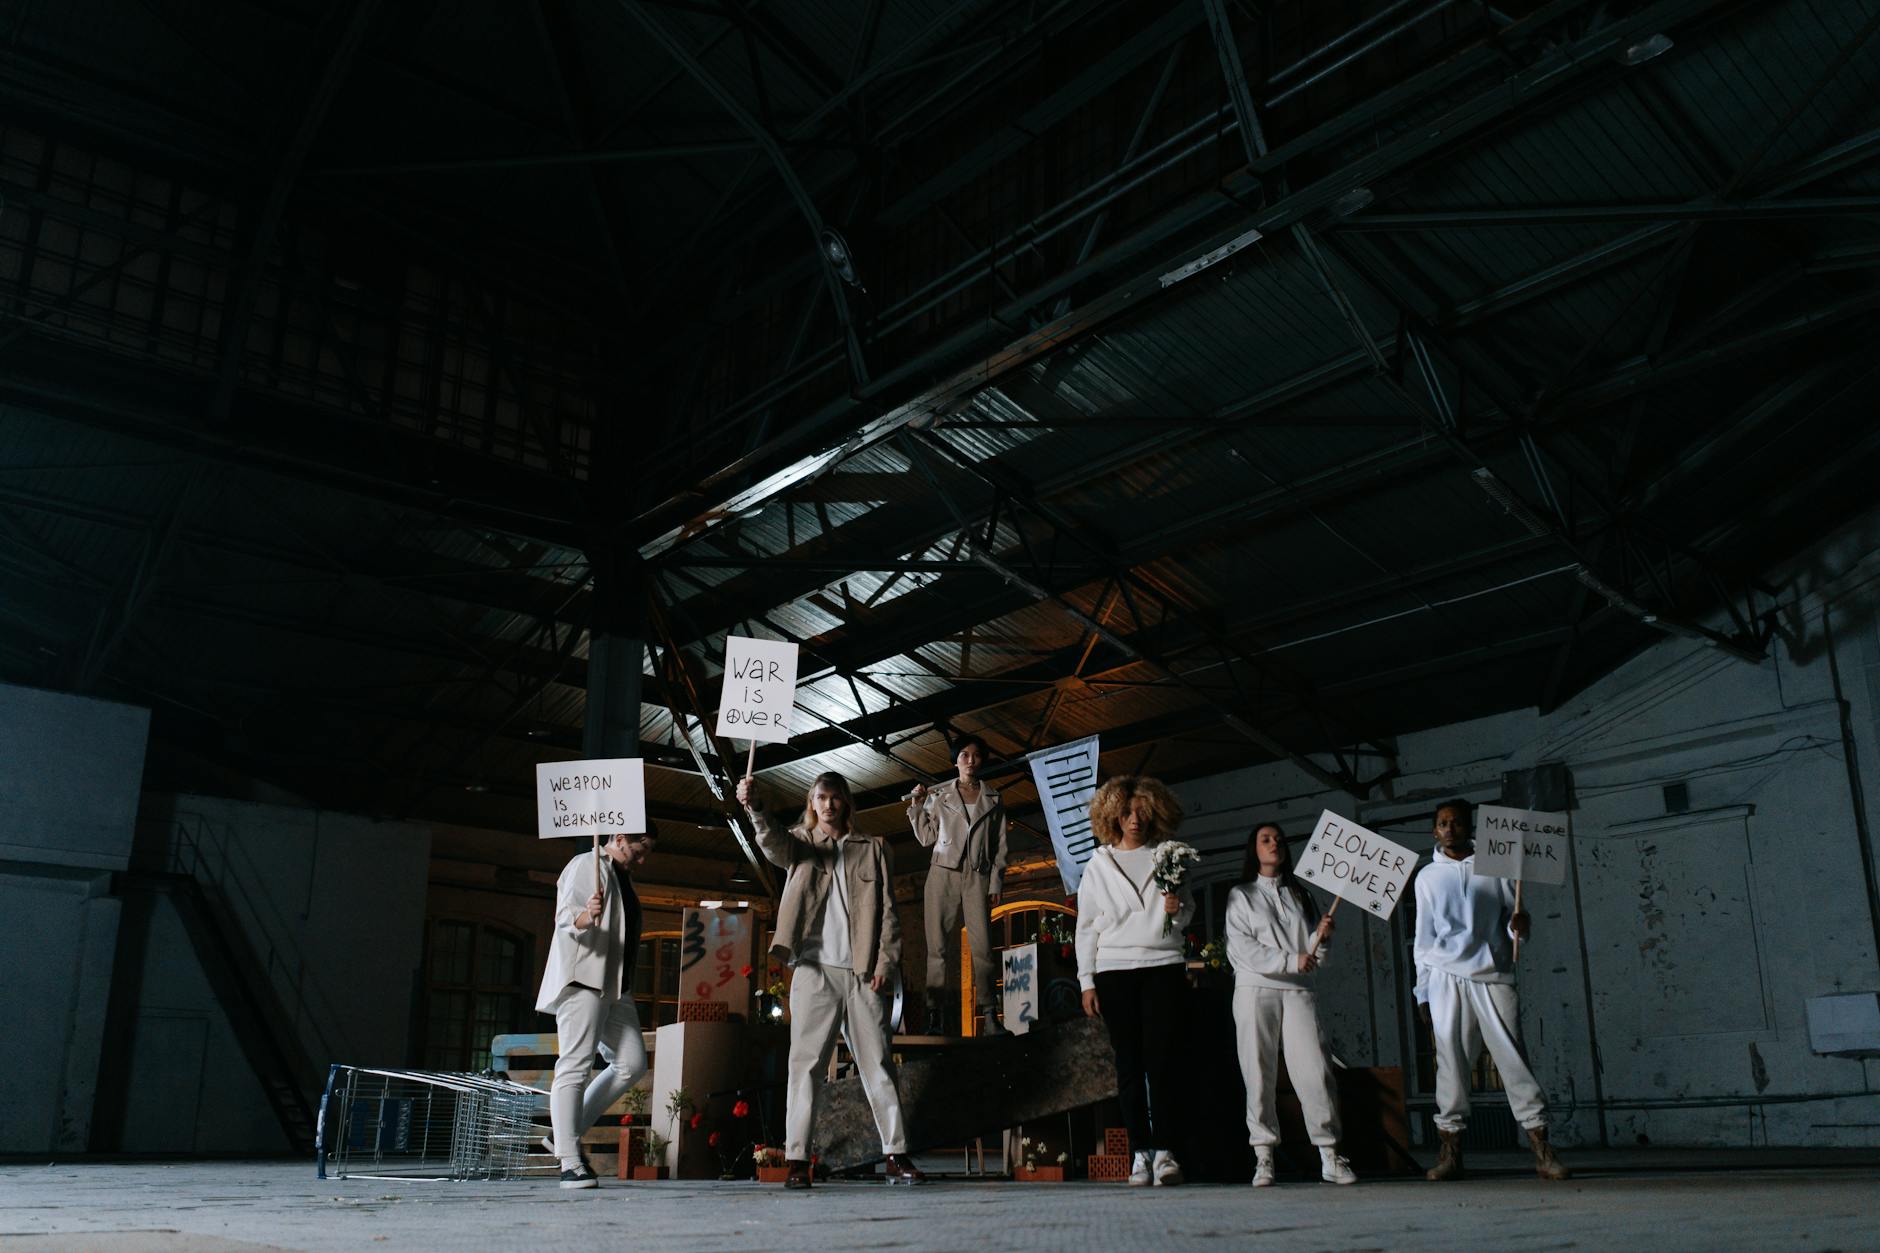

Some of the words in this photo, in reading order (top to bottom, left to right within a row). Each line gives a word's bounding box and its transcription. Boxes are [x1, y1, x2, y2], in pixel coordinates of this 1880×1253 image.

[744, 686, 764, 704] is
[1044, 750, 1099, 880] FREEDO
[1321, 822, 1405, 876] FLOWER
[1488, 838, 1518, 856] NOT
[1522, 841, 1558, 862] WAR
[1321, 852, 1397, 903] POWER
